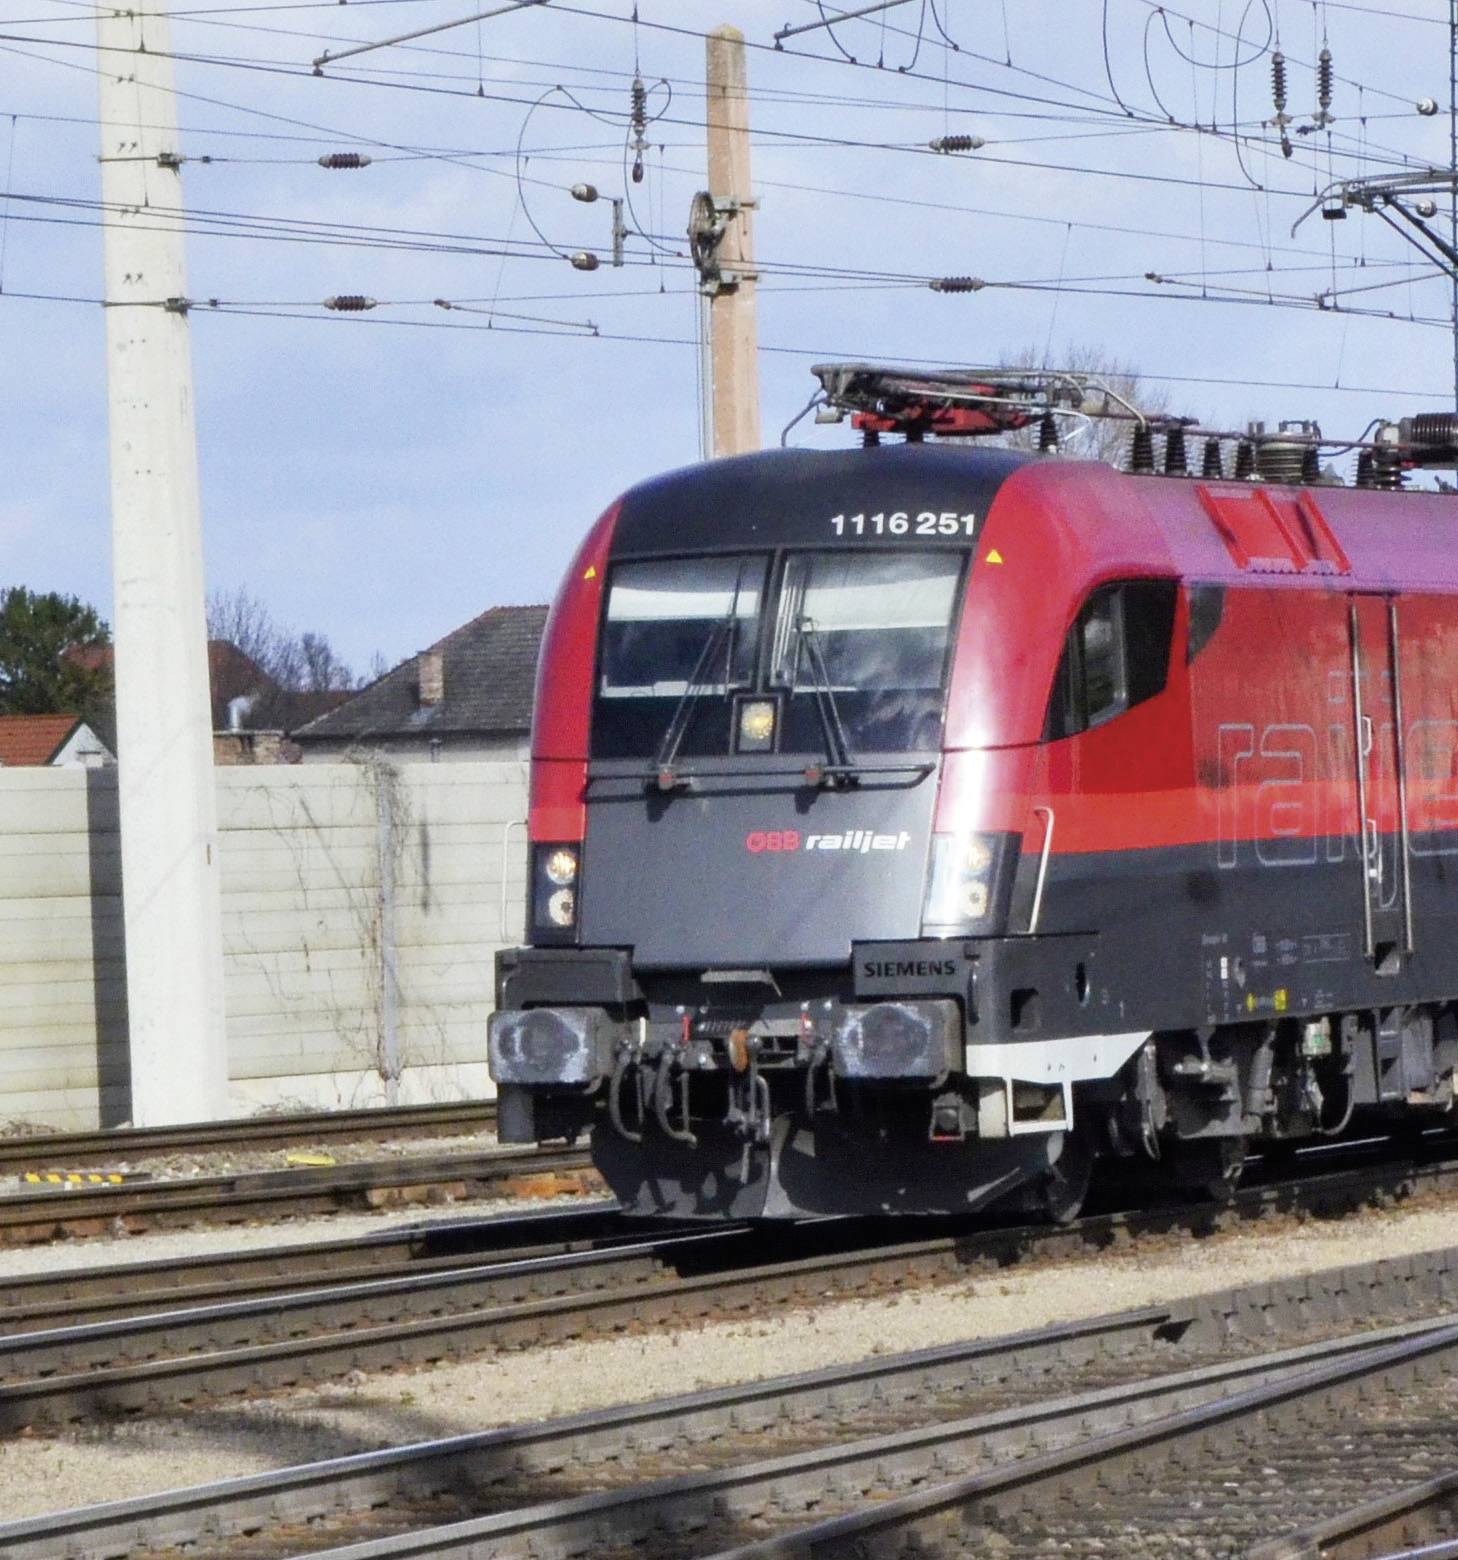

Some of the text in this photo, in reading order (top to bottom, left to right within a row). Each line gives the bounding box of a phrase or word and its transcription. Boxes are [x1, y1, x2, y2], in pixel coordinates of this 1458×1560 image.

[831, 512, 975, 536] 1116 251
[806, 830, 912, 854] railjet
[863, 960, 956, 978] SIEMENS
